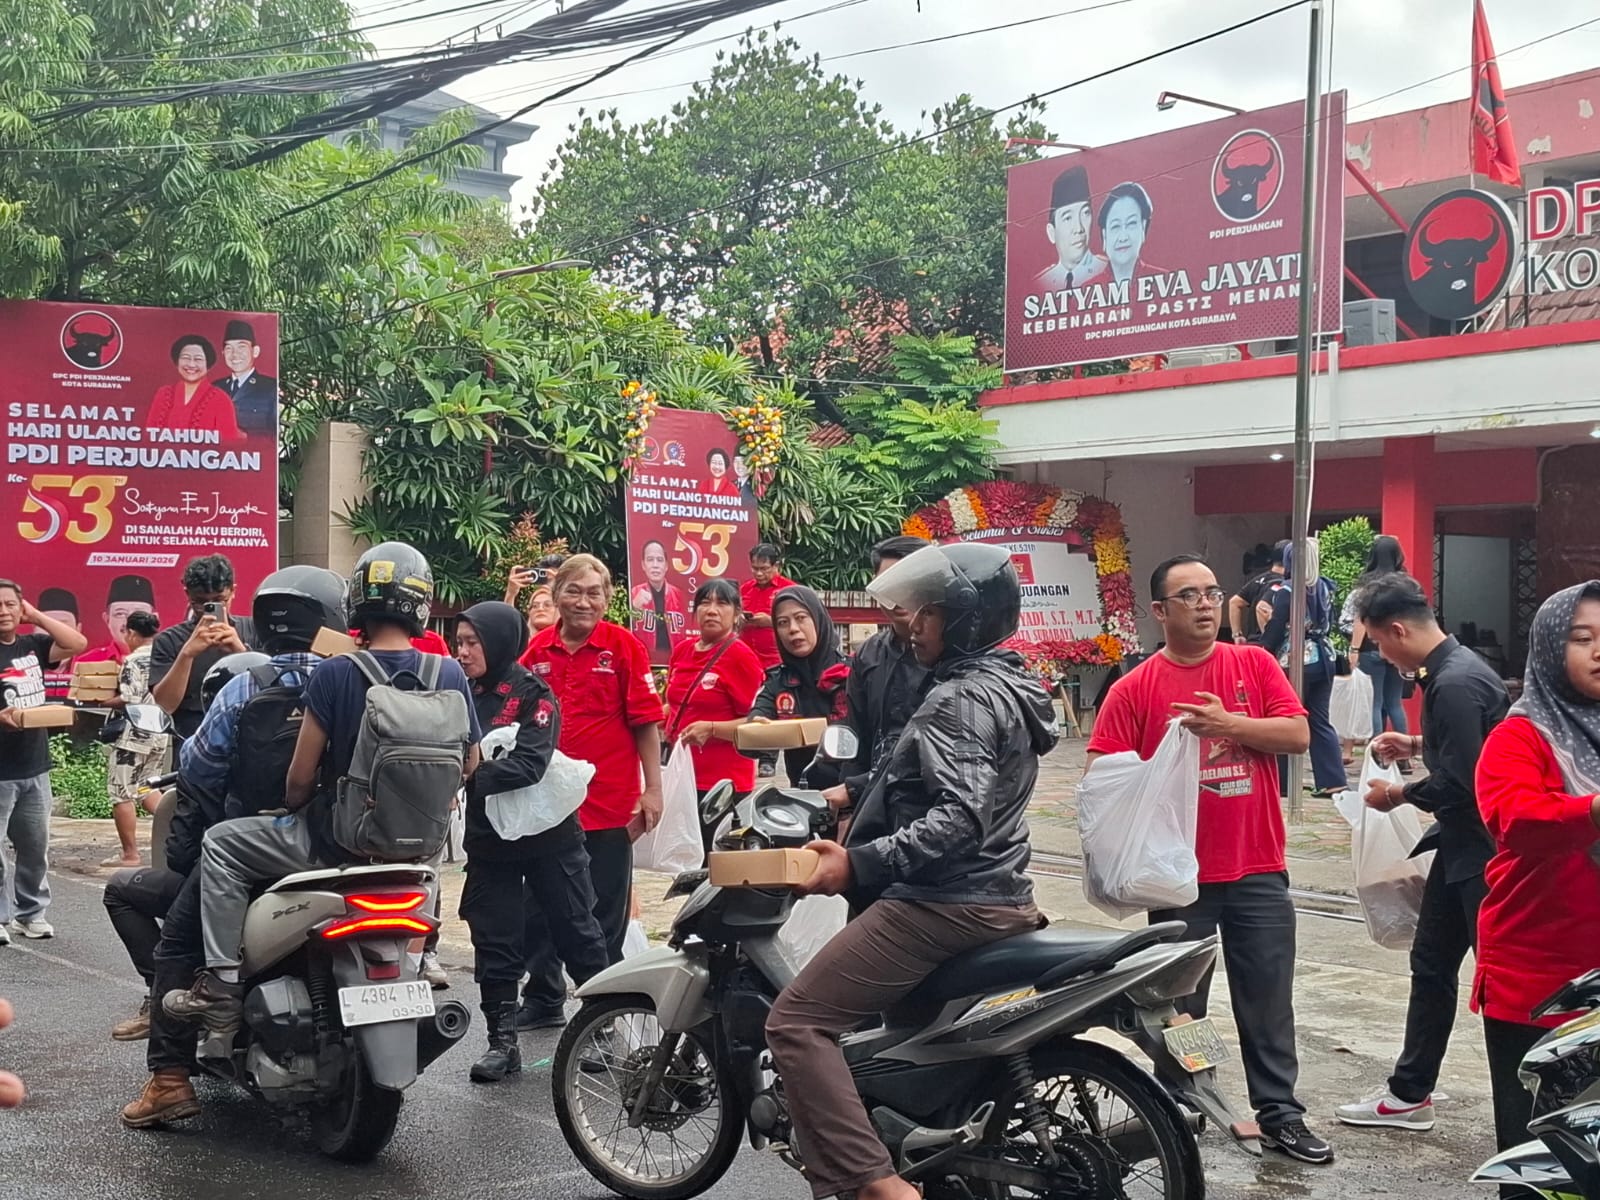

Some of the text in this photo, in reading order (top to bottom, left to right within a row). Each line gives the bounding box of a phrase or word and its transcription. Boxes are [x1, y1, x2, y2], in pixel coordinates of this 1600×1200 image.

[1209, 219, 1283, 239] PDI PERJUANGAN
[1024, 279, 1130, 319] SATYAM
[1137, 269, 1192, 302] EVA
[1023, 282, 1316, 335] KEBENARAN PASTI MENAN
[1085, 331, 1100, 340] DPC
[1116, 323, 1167, 336] PERJUANGAN
[1168, 318, 1191, 329] KOTA
[1191, 312, 1237, 326] SURABAYA
[83, 374, 131, 382] PERJUANGAN
[8, 402, 136, 422] SELAMAT
[8, 422, 220, 445] HARI ULANG TAHUN
[8, 443, 261, 472] PDI PERJUANGAN
[632, 475, 698, 489] SELAMAT
[632, 487, 742, 507] HARI ULANG TAHUN
[7, 474, 127, 544] Ke- 53
[633, 501, 749, 522] PDI PERJUANGAN
[121, 535, 269, 547] UNTUK SELAMA-LAMANYA
[125, 525, 265, 538] DI SANALAH AKU BERDIRI,
[92, 554, 175, 564] 10 JANUARI 2026
[672, 521, 738, 577] 53
[1021, 584, 1070, 597] JUANGAN
[1033, 628, 1075, 642] SURABAYA
[342, 983, 430, 1007] L 4384 PM
[392, 1004, 432, 1018] 03-30
